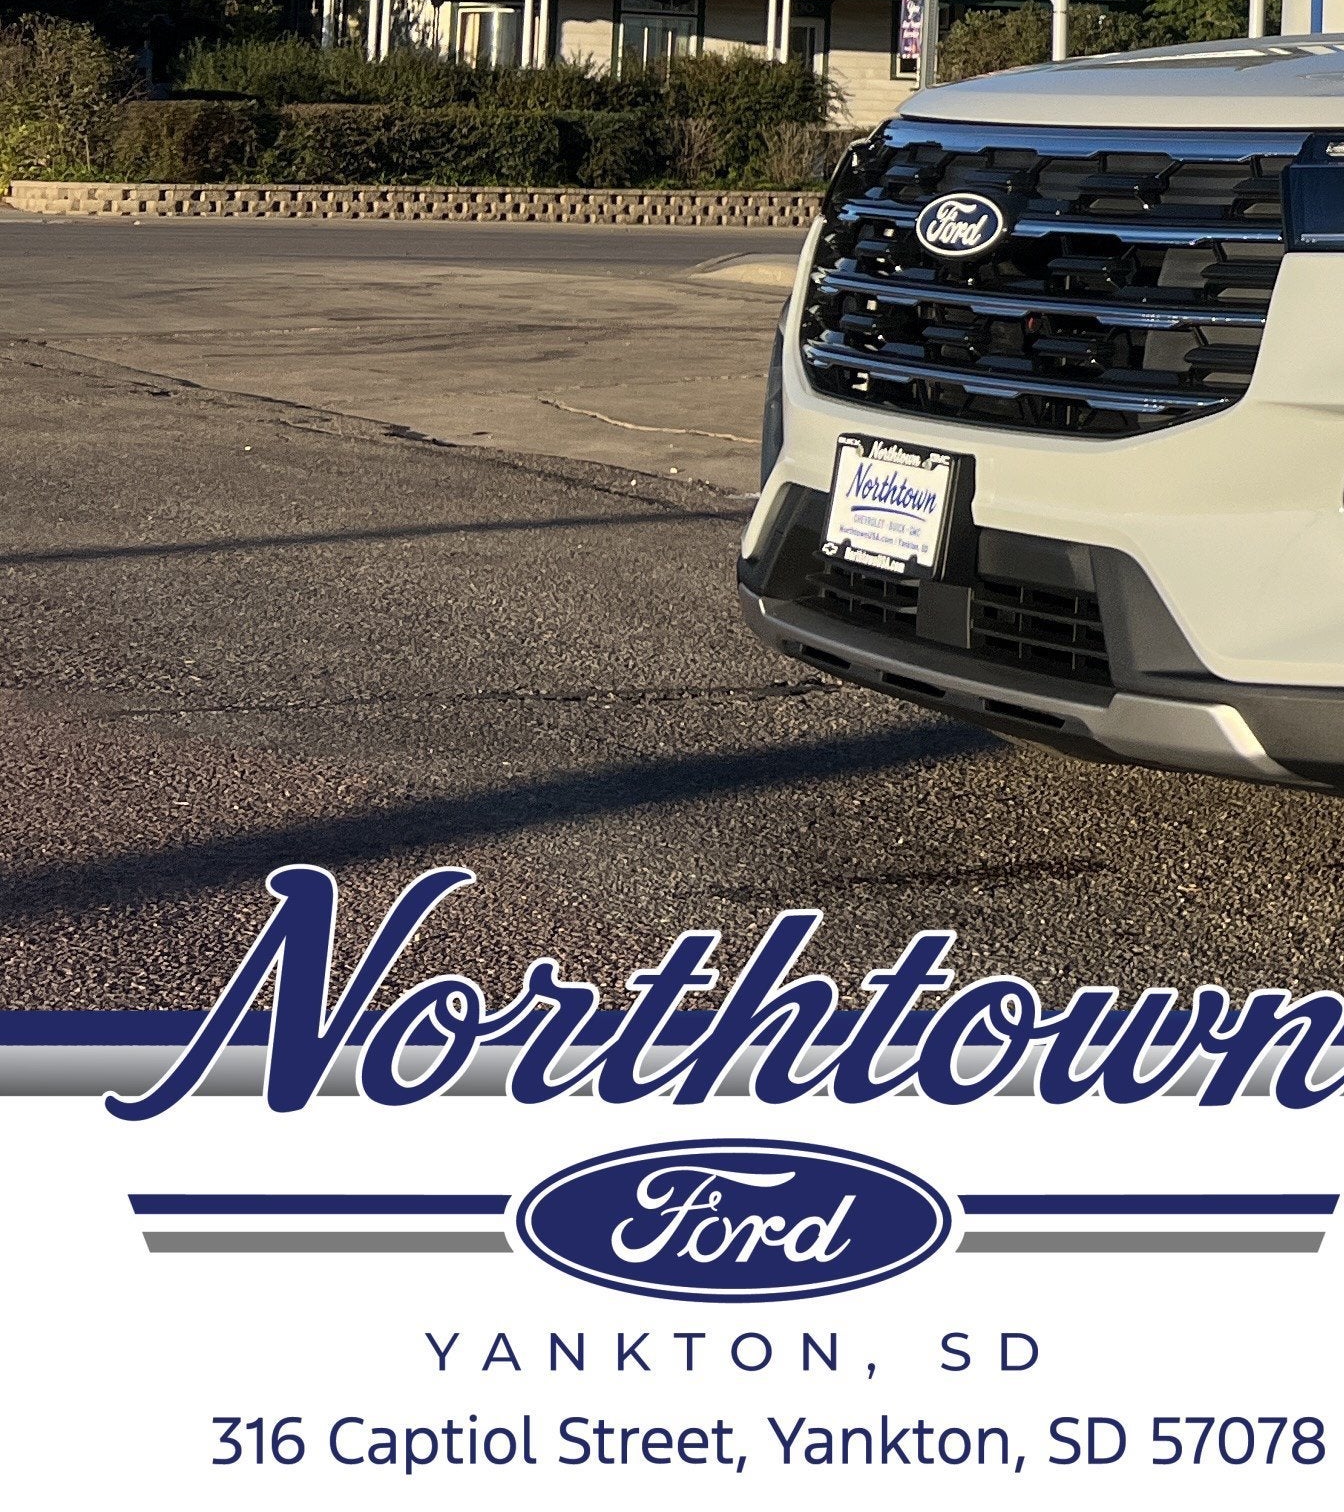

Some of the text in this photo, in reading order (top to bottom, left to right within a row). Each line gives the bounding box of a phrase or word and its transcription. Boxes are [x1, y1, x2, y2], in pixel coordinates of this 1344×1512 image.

[926, 200, 989, 246] Ford
[868, 440, 921, 467] Northtown
[845, 462, 938, 514] Northtown
